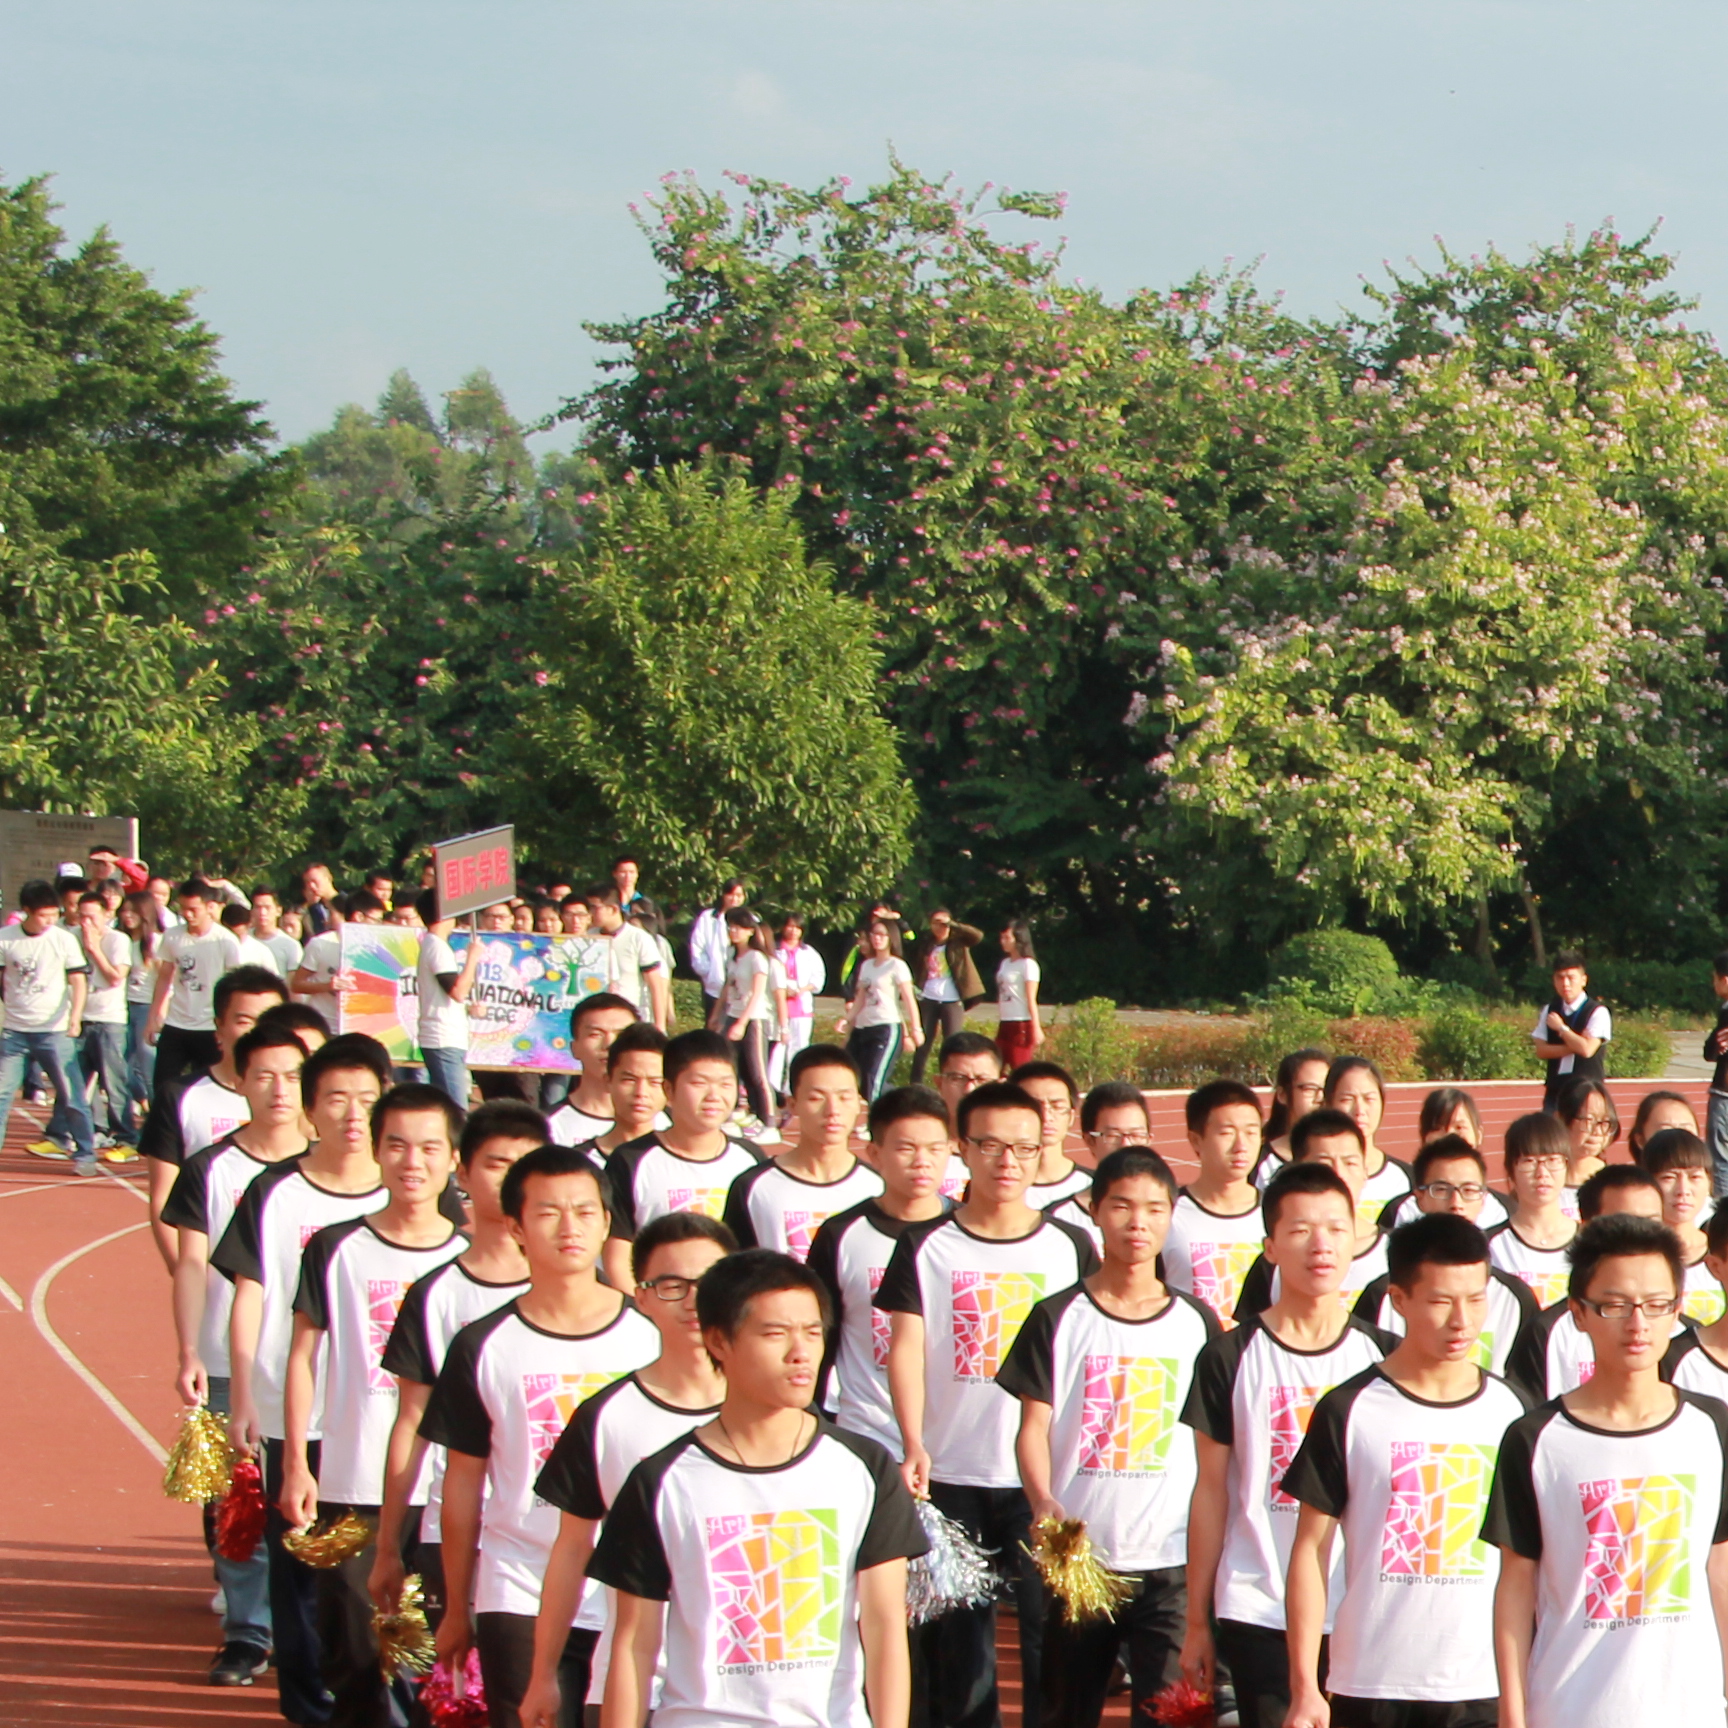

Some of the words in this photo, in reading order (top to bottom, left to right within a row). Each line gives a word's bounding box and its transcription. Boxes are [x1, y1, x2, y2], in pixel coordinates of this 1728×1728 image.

[443, 846, 511, 901] 国际学院
[1191, 1243, 1214, 1254] Art
[951, 1271, 980, 1284] Art
[368, 1280, 397, 1293] Art
[1085, 1356, 1113, 1369] Art
[523, 1376, 557, 1389] Art
[369, 1386, 397, 1397] Desig
[1390, 1442, 1424, 1457] Art
[1077, 1468, 1111, 1478] Design
[1579, 1481, 1617, 1497] Art
[1271, 1504, 1299, 1514] Desig
[706, 1516, 749, 1536] Art
[1380, 1573, 1422, 1585] Design
[1583, 1620, 1625, 1631] Design
[716, 1664, 765, 1677] Design
